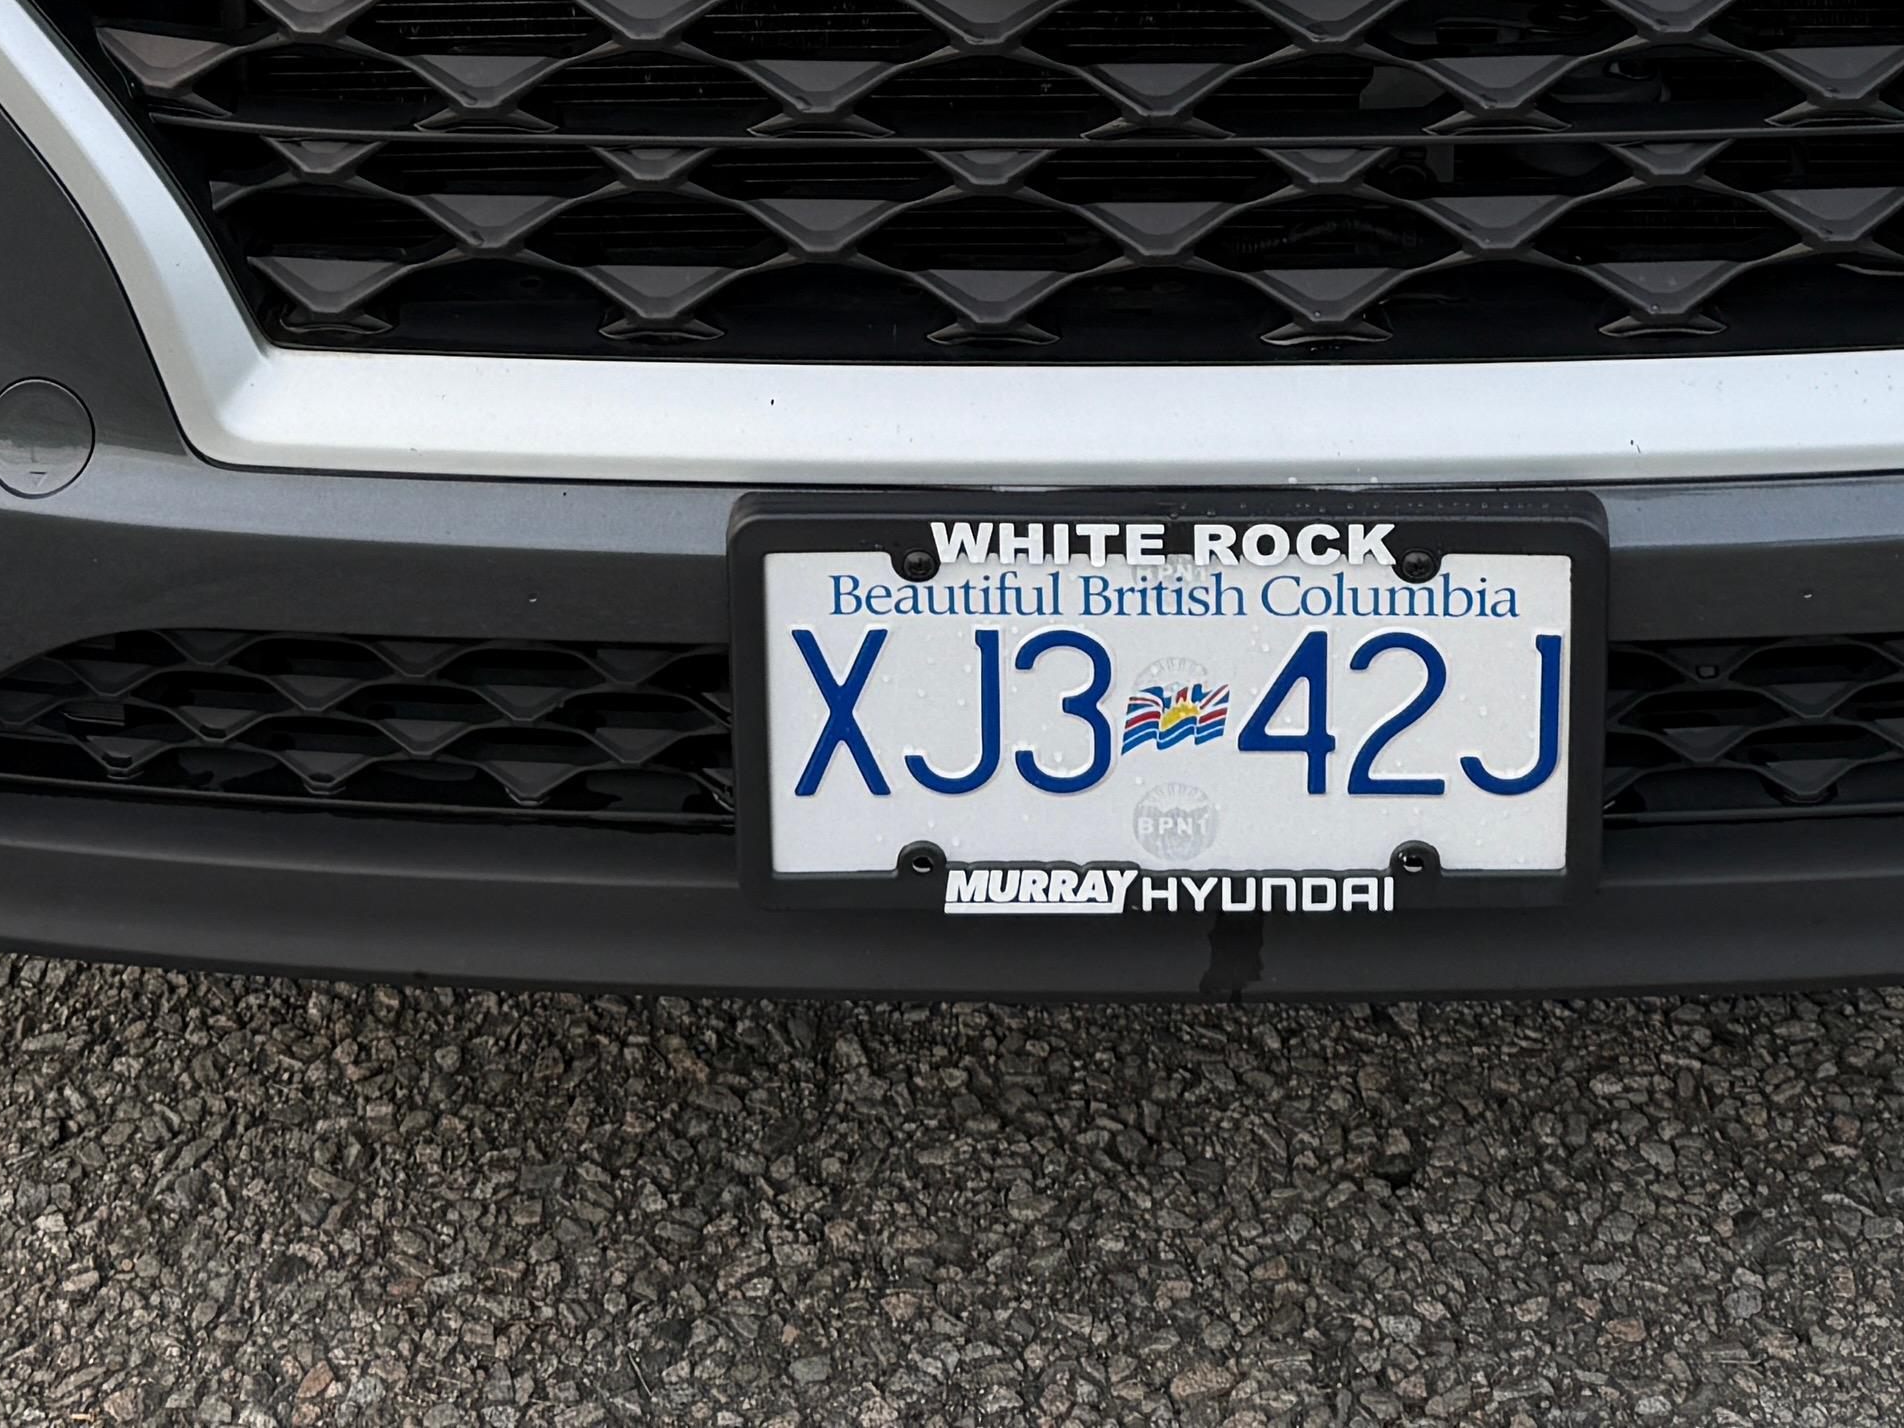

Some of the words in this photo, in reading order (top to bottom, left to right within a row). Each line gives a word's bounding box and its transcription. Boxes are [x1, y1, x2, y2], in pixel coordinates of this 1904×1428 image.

[930, 521, 1166, 567] WHITE
[1193, 523, 1397, 566] ROCK
[830, 573, 1063, 618] Beautiful
[1081, 572, 1248, 618] British
[1260, 573, 1519, 618] Columbia
[791, 627, 1114, 798] XJ3
[1236, 629, 1565, 798] 42J
[944, 869, 1138, 913] MURRAY
[1142, 876, 1394, 912] HYUNDAI
